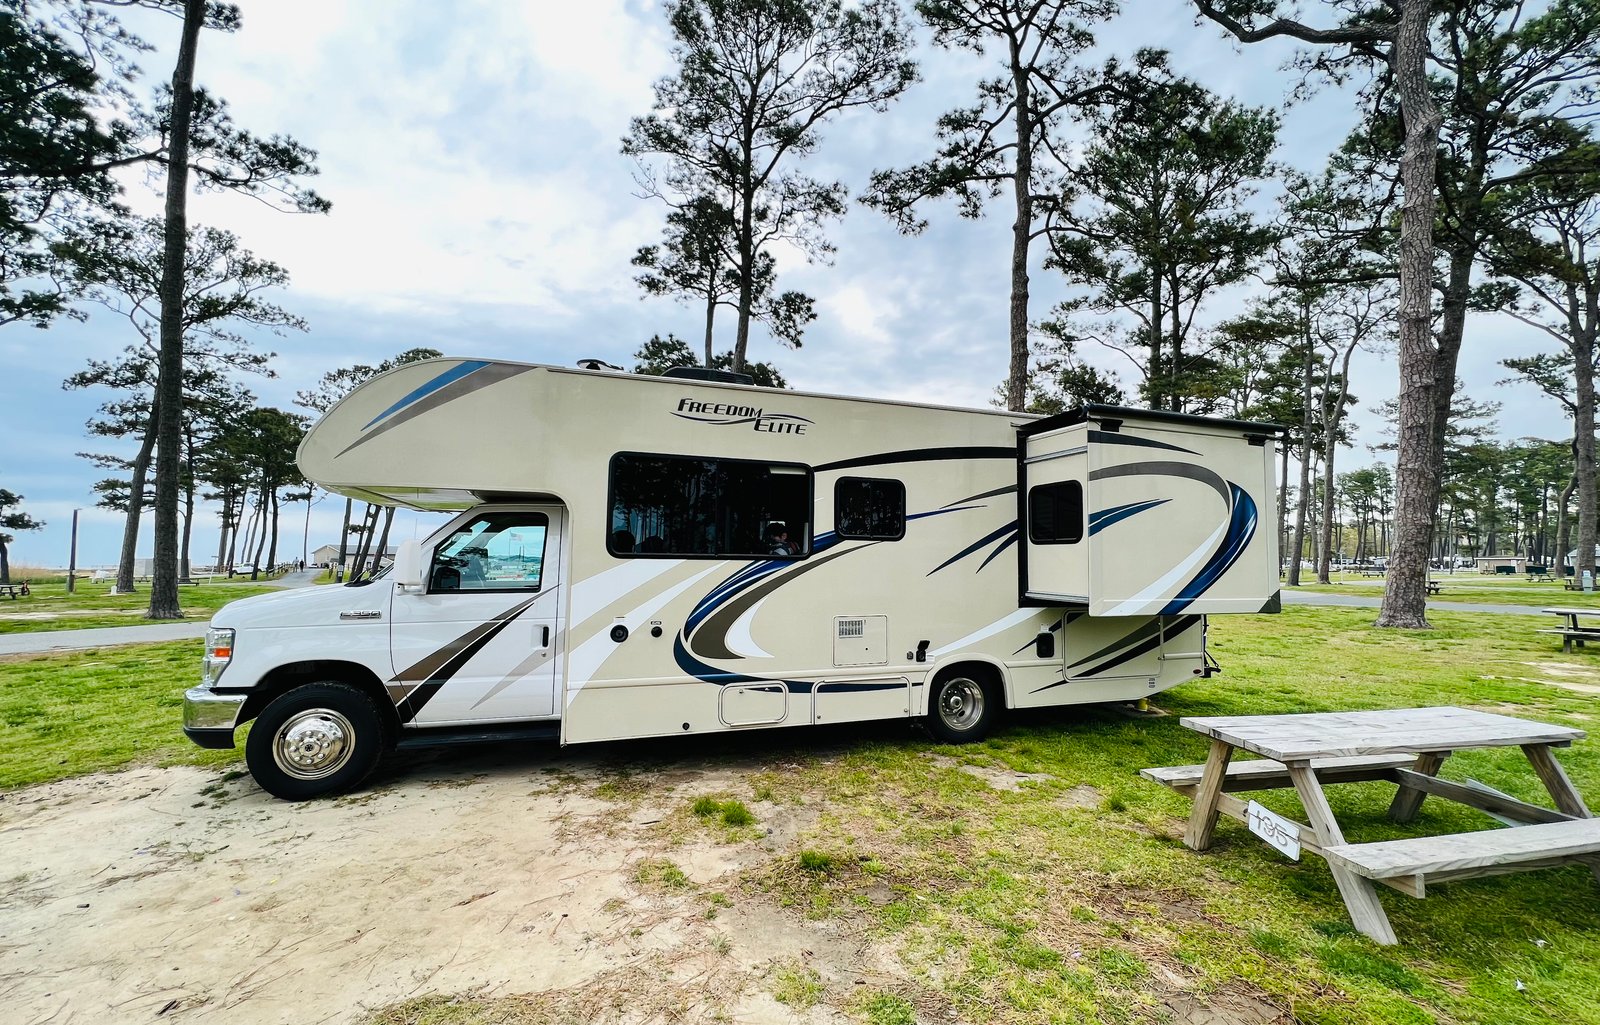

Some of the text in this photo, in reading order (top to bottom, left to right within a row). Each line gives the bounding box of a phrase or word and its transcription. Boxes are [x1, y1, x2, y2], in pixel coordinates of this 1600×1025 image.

[677, 398, 763, 418] FREEDOM
[753, 418, 808, 435] ELITE
[1256, 810, 1289, 847] 195
